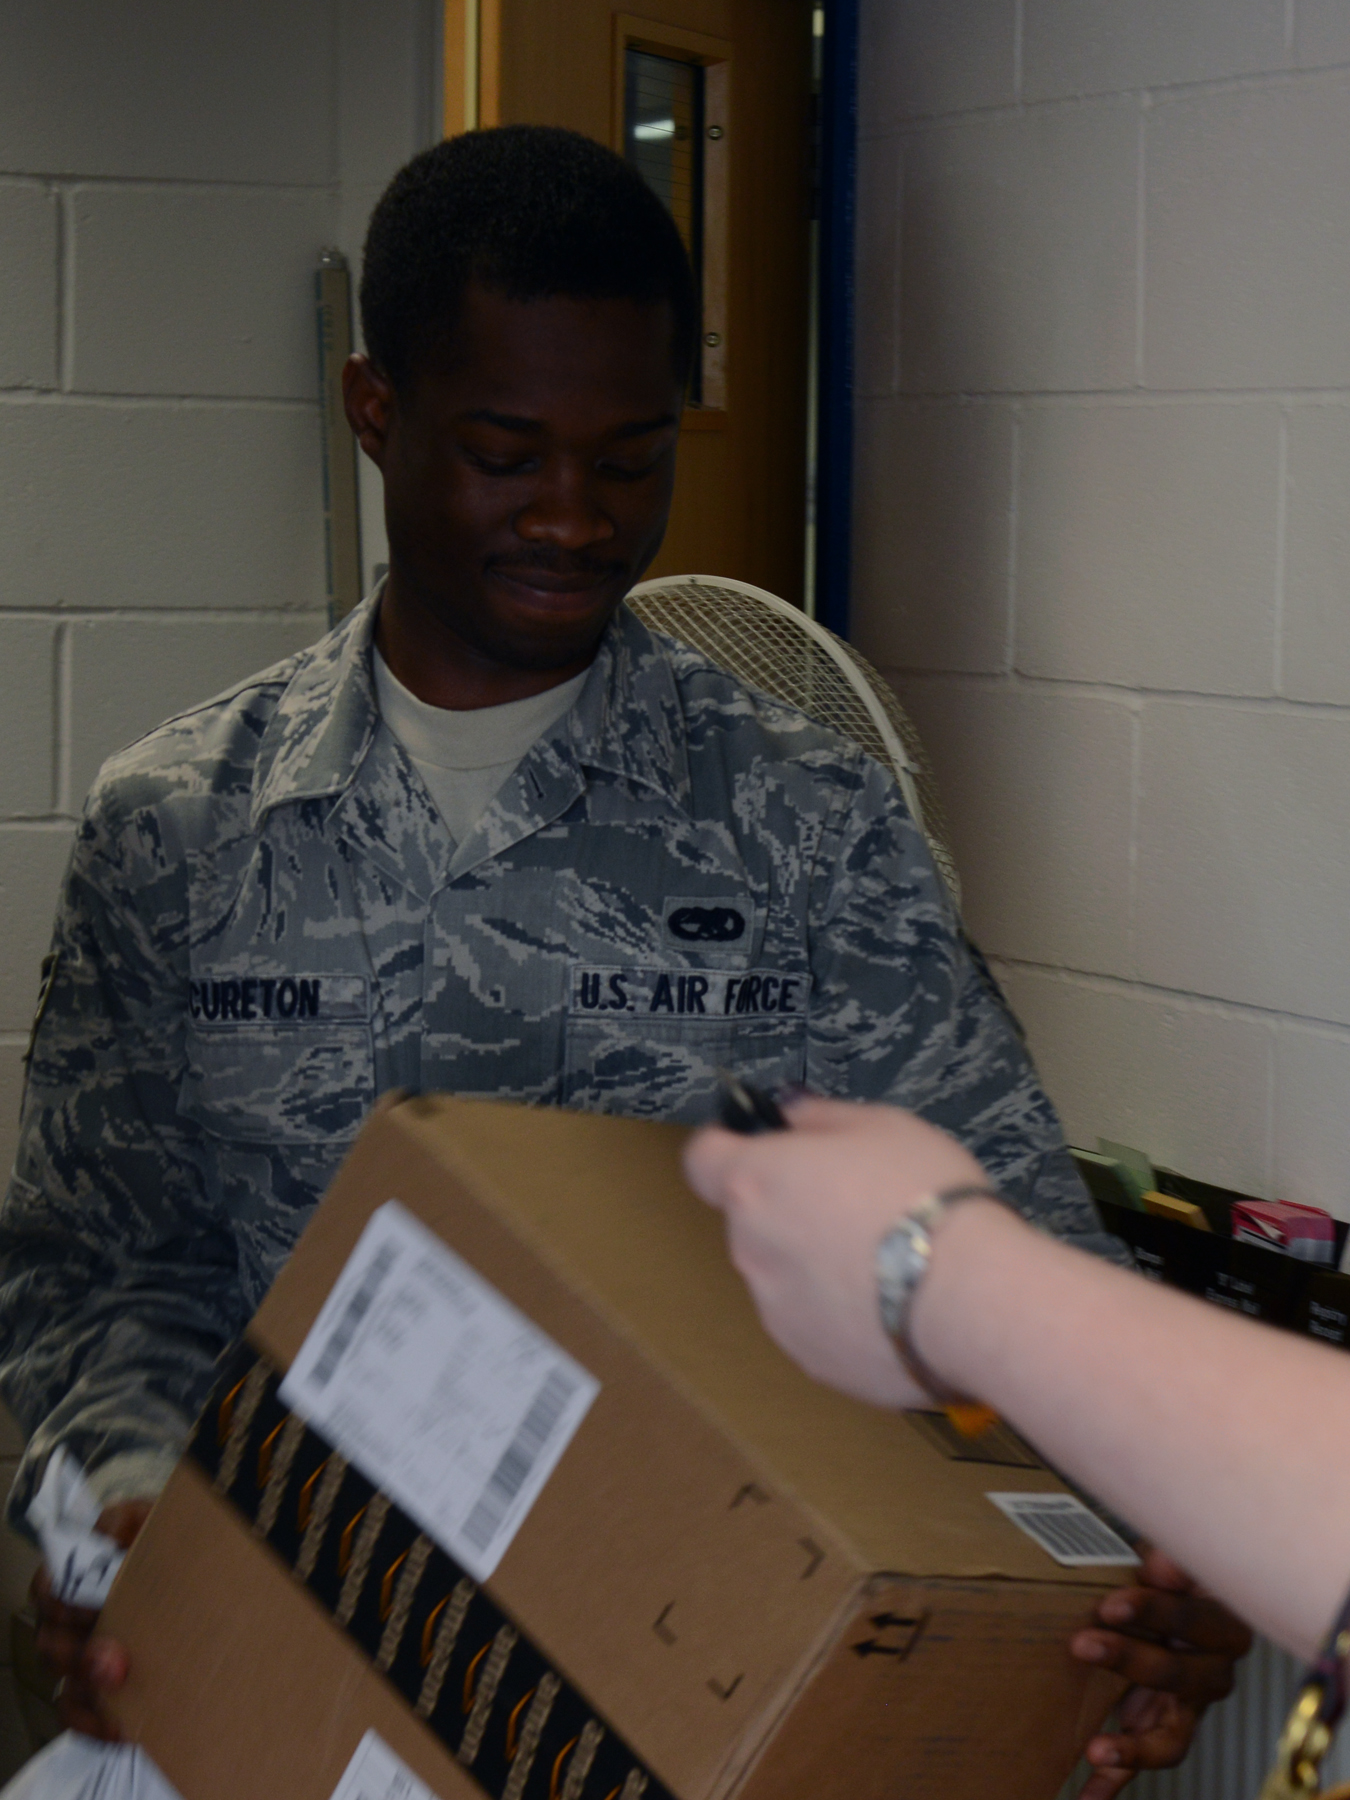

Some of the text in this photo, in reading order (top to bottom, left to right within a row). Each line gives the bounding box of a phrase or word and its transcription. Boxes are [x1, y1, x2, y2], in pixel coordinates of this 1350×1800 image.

[190, 979, 321, 1020] CURETON
[581, 973, 799, 1014] U.S. AIR FORCE
